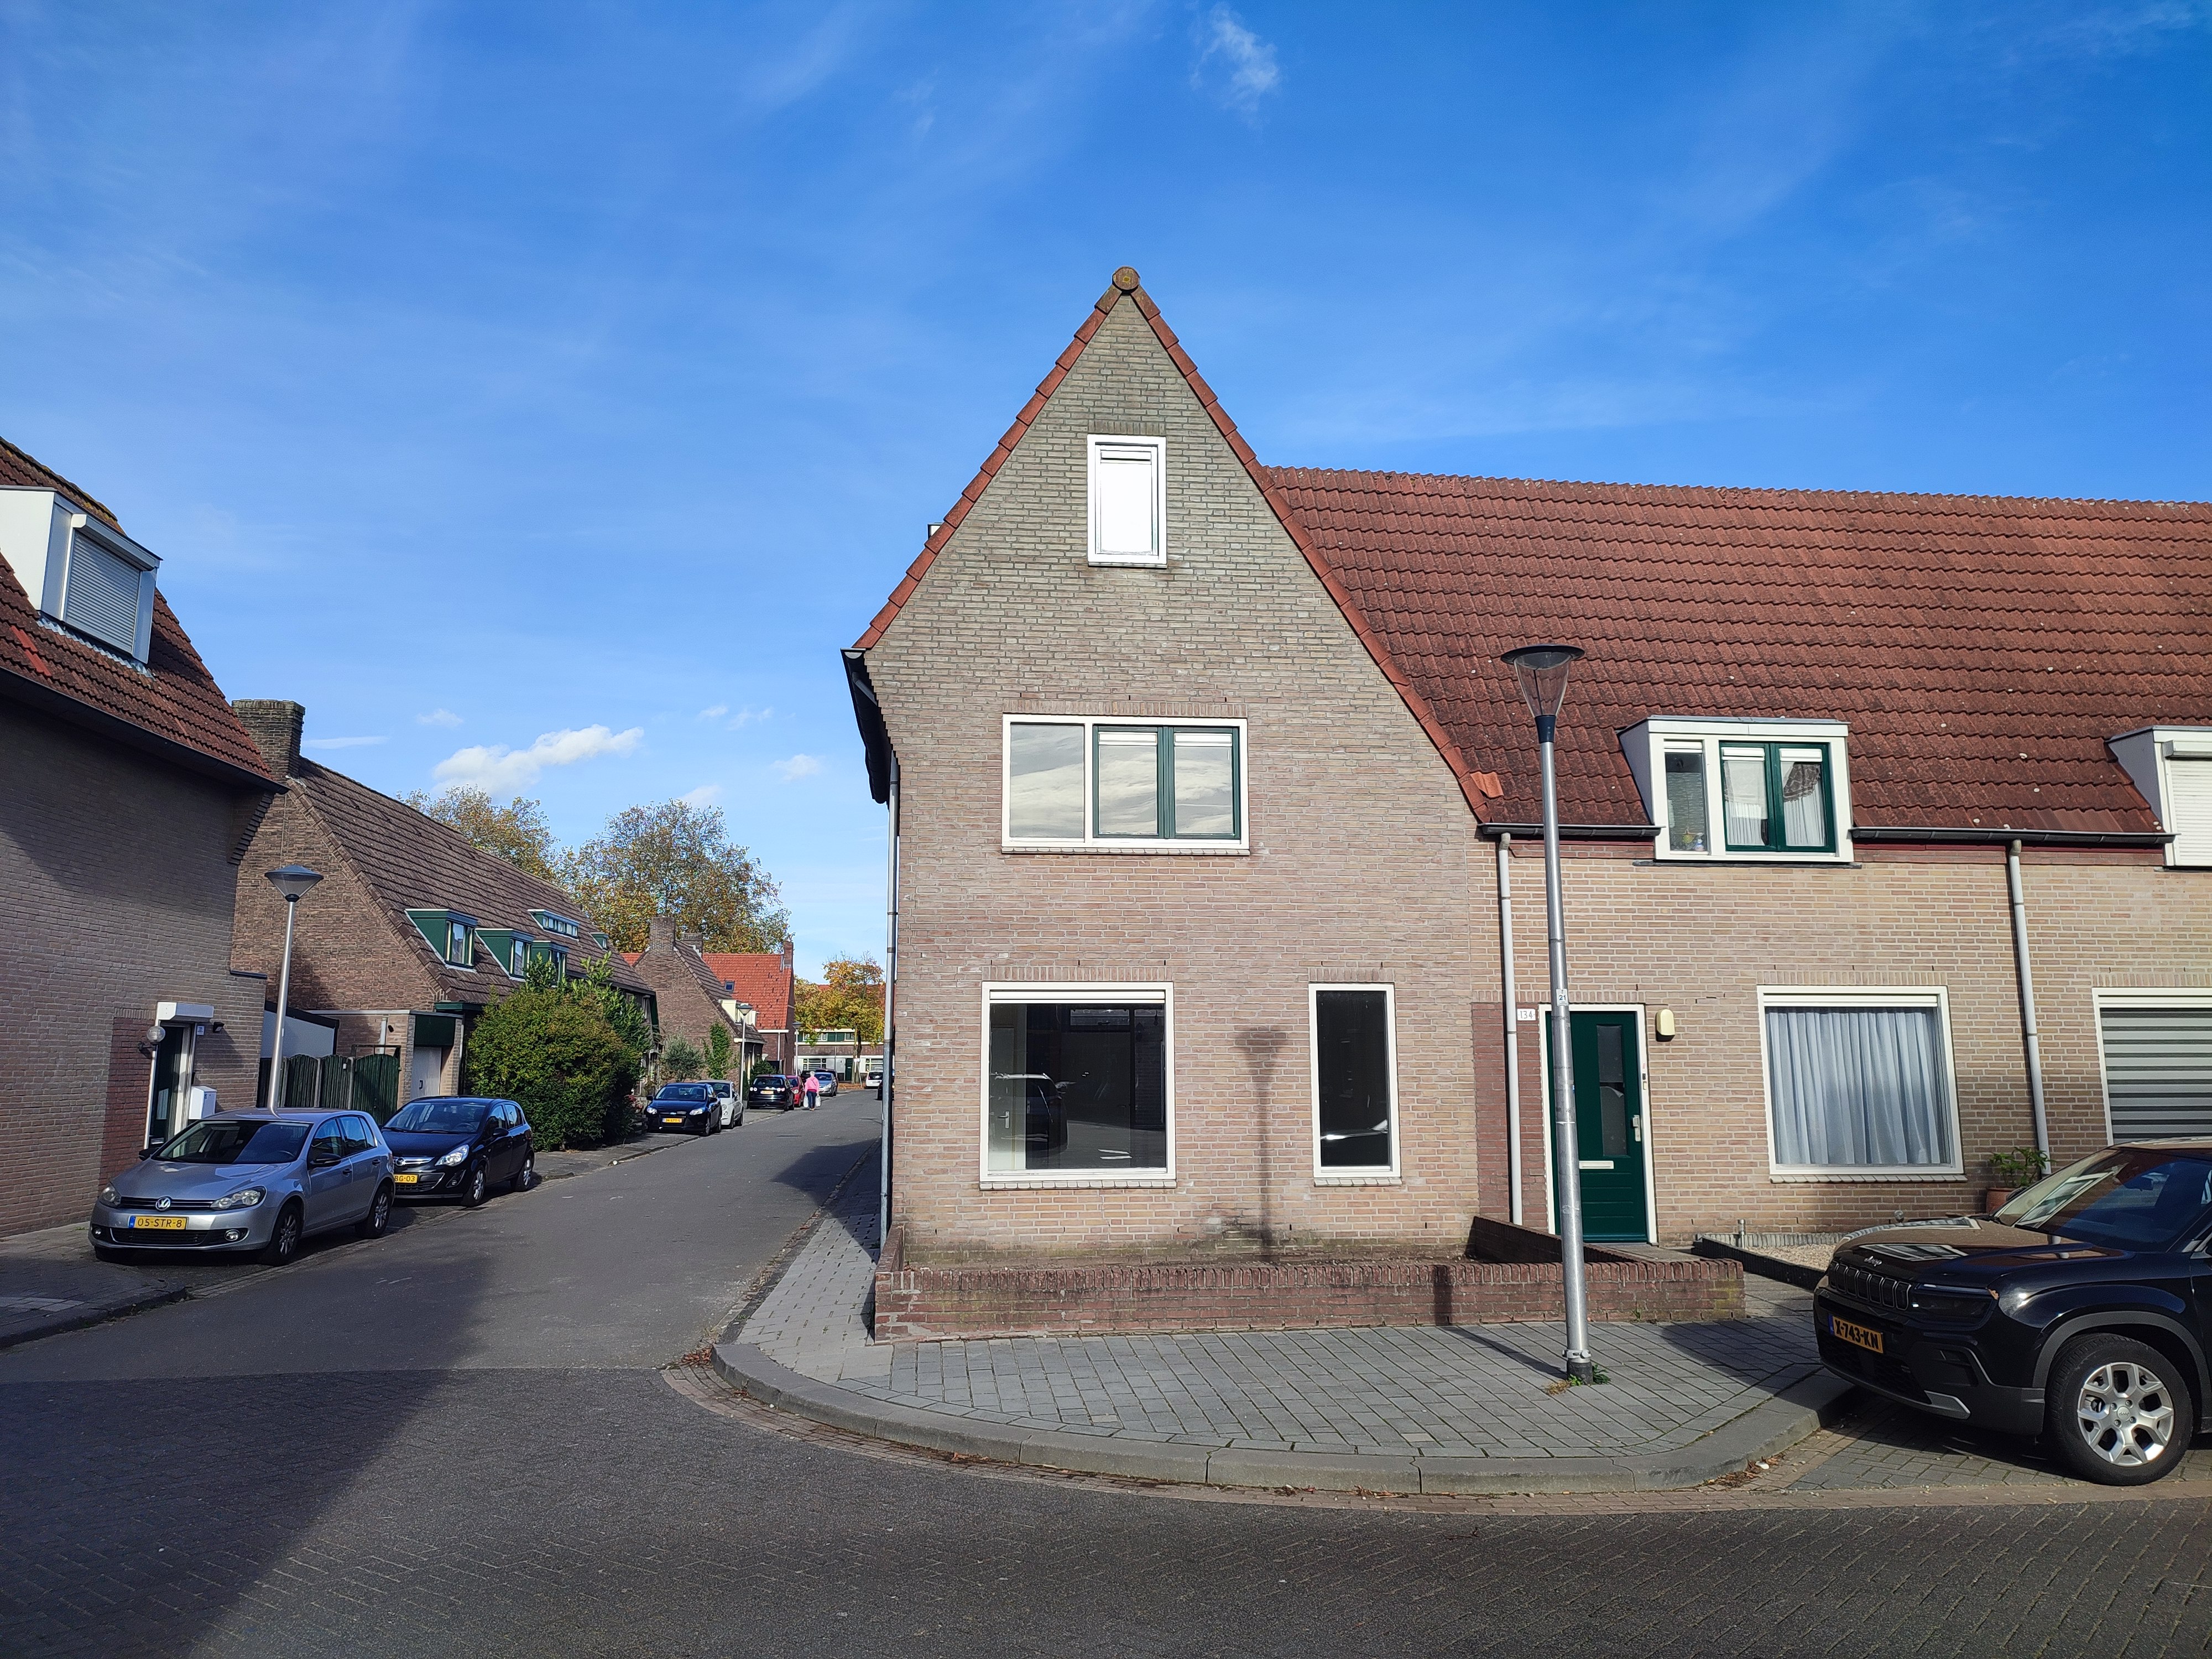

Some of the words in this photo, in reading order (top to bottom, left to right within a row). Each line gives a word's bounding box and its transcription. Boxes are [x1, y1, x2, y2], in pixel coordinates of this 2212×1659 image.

[1520, 1010, 1533, 1019] 134
[137, 1218, 182, 1228] 05-STR-8
[1834, 1319, 1879, 1349] X-743-KN
